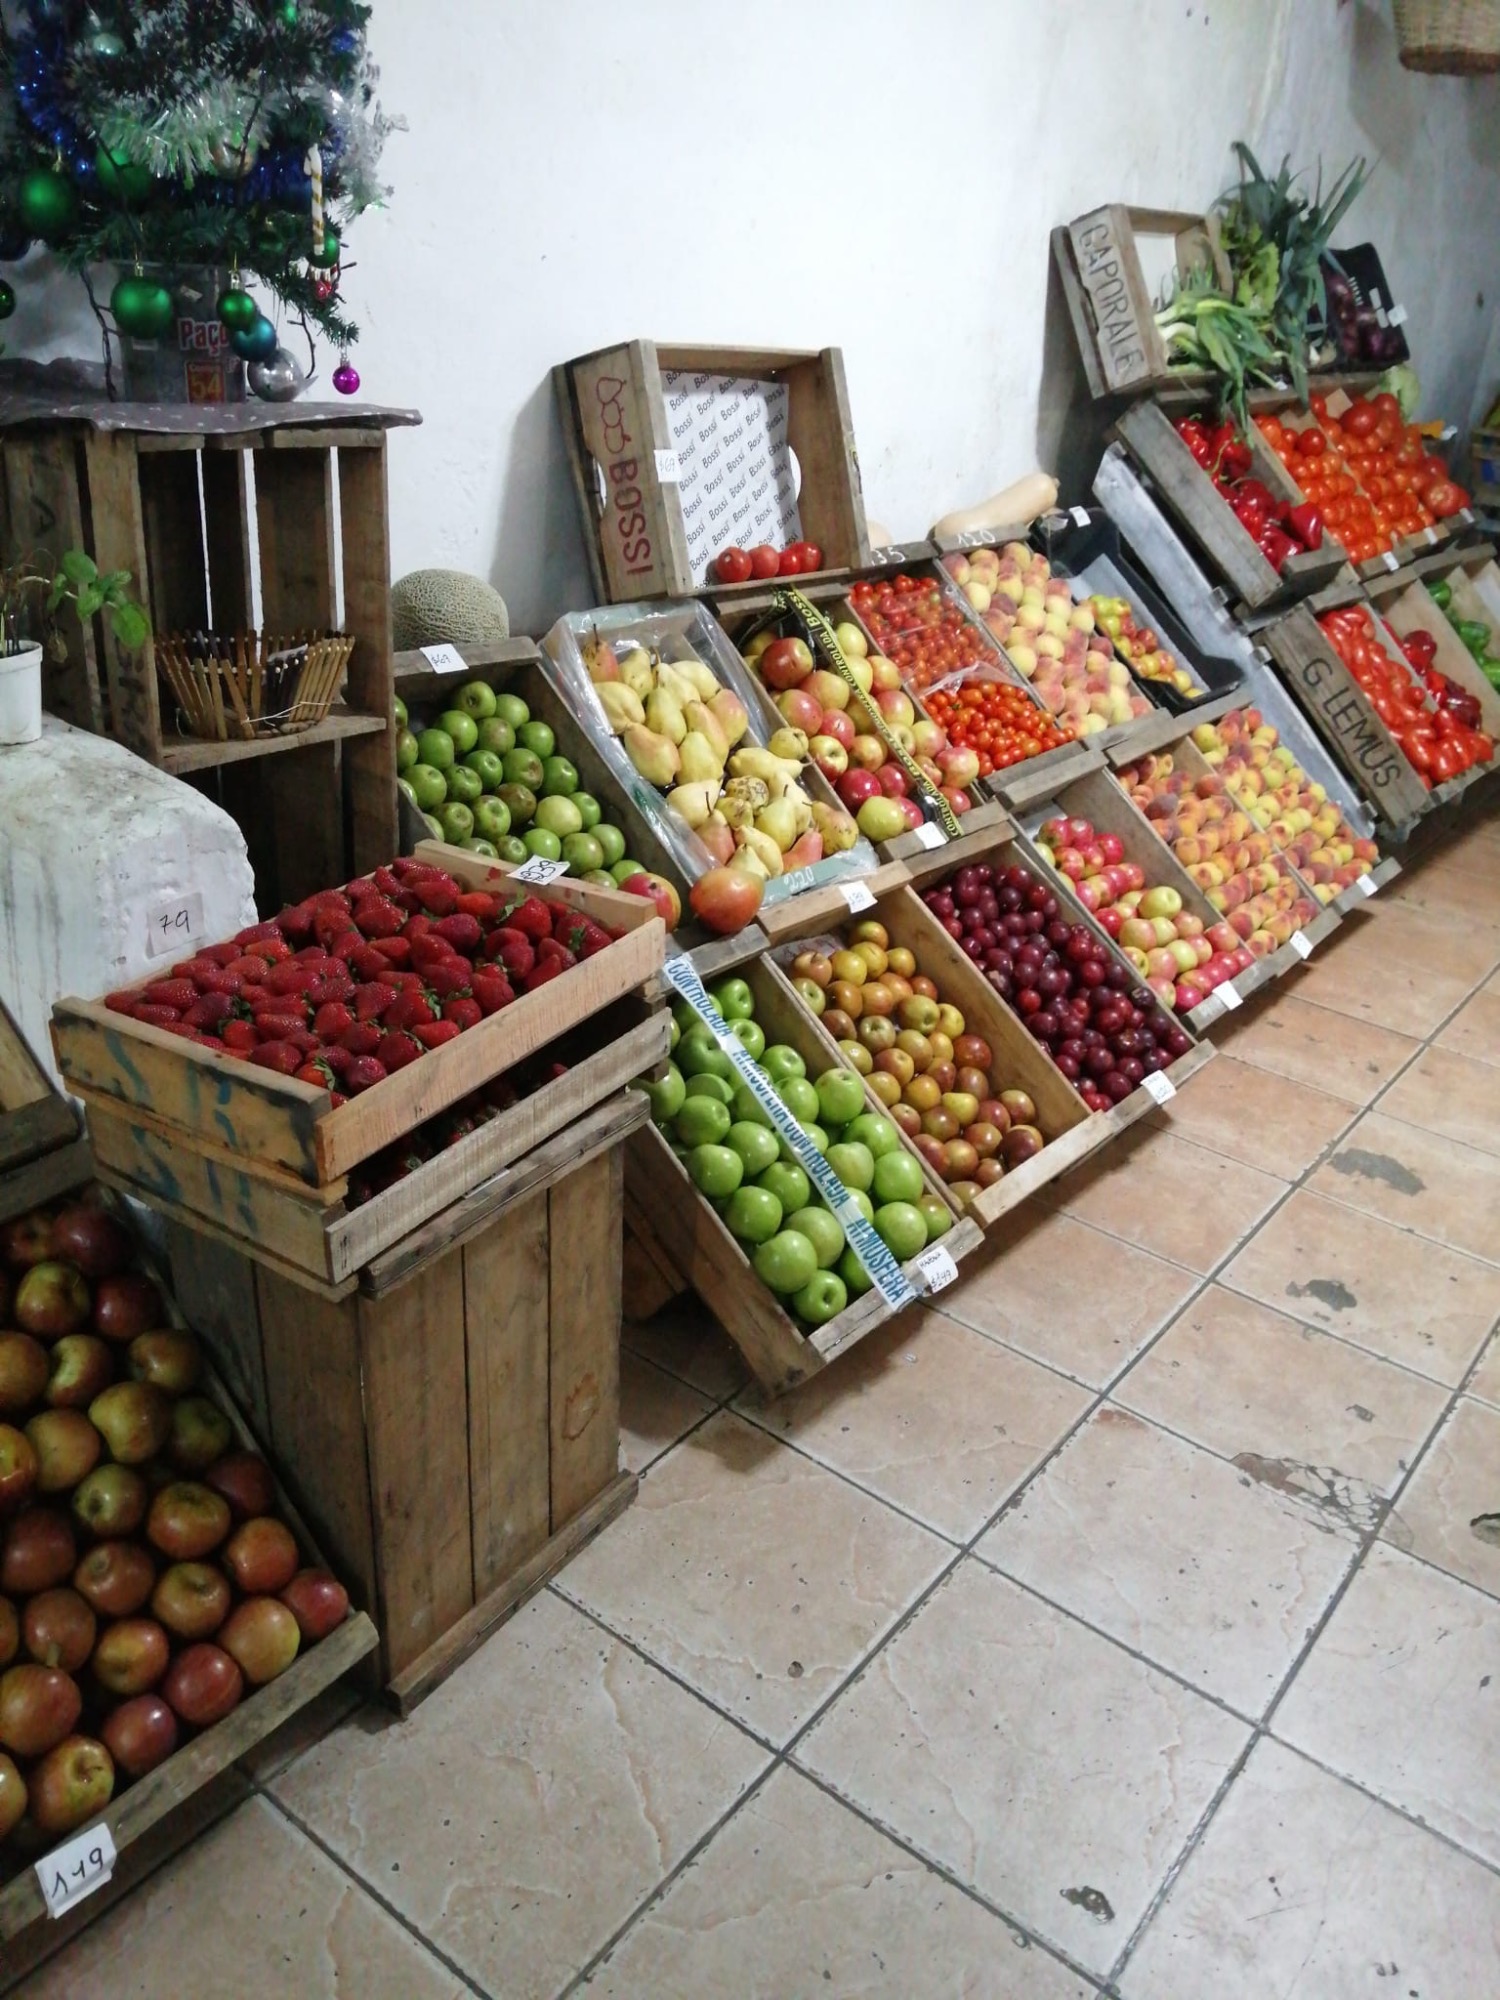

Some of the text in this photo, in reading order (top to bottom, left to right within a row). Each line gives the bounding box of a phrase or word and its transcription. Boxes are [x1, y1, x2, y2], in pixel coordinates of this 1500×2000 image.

[696, 390, 716, 415] Bossi
[673, 411, 693, 438] Bossi
[699, 416, 718, 442] Bossi
[723, 422, 743, 447] Bossi
[702, 441, 721, 469] Bossi
[726, 447, 745, 473] Bossi
[609, 458, 654, 575] BOSSI
[683, 493, 703, 519] Bossi
[708, 496, 729, 521] Bossi
[686, 518, 706, 545] Bossi
[711, 520, 731, 546] Bossi
[689, 544, 710, 571] Bossi
[819, 631, 857, 688] CONTROLADA
[1303, 658, 1401, 787] G LEMUS
[784, 866, 815, 893] 220
[159, 909, 190, 936] 79
[668, 963, 732, 1037] CONTROLADA
[783, 1120, 851, 1209] CONTROLADA
[846, 1218, 909, 1303] ATMOSFERA
